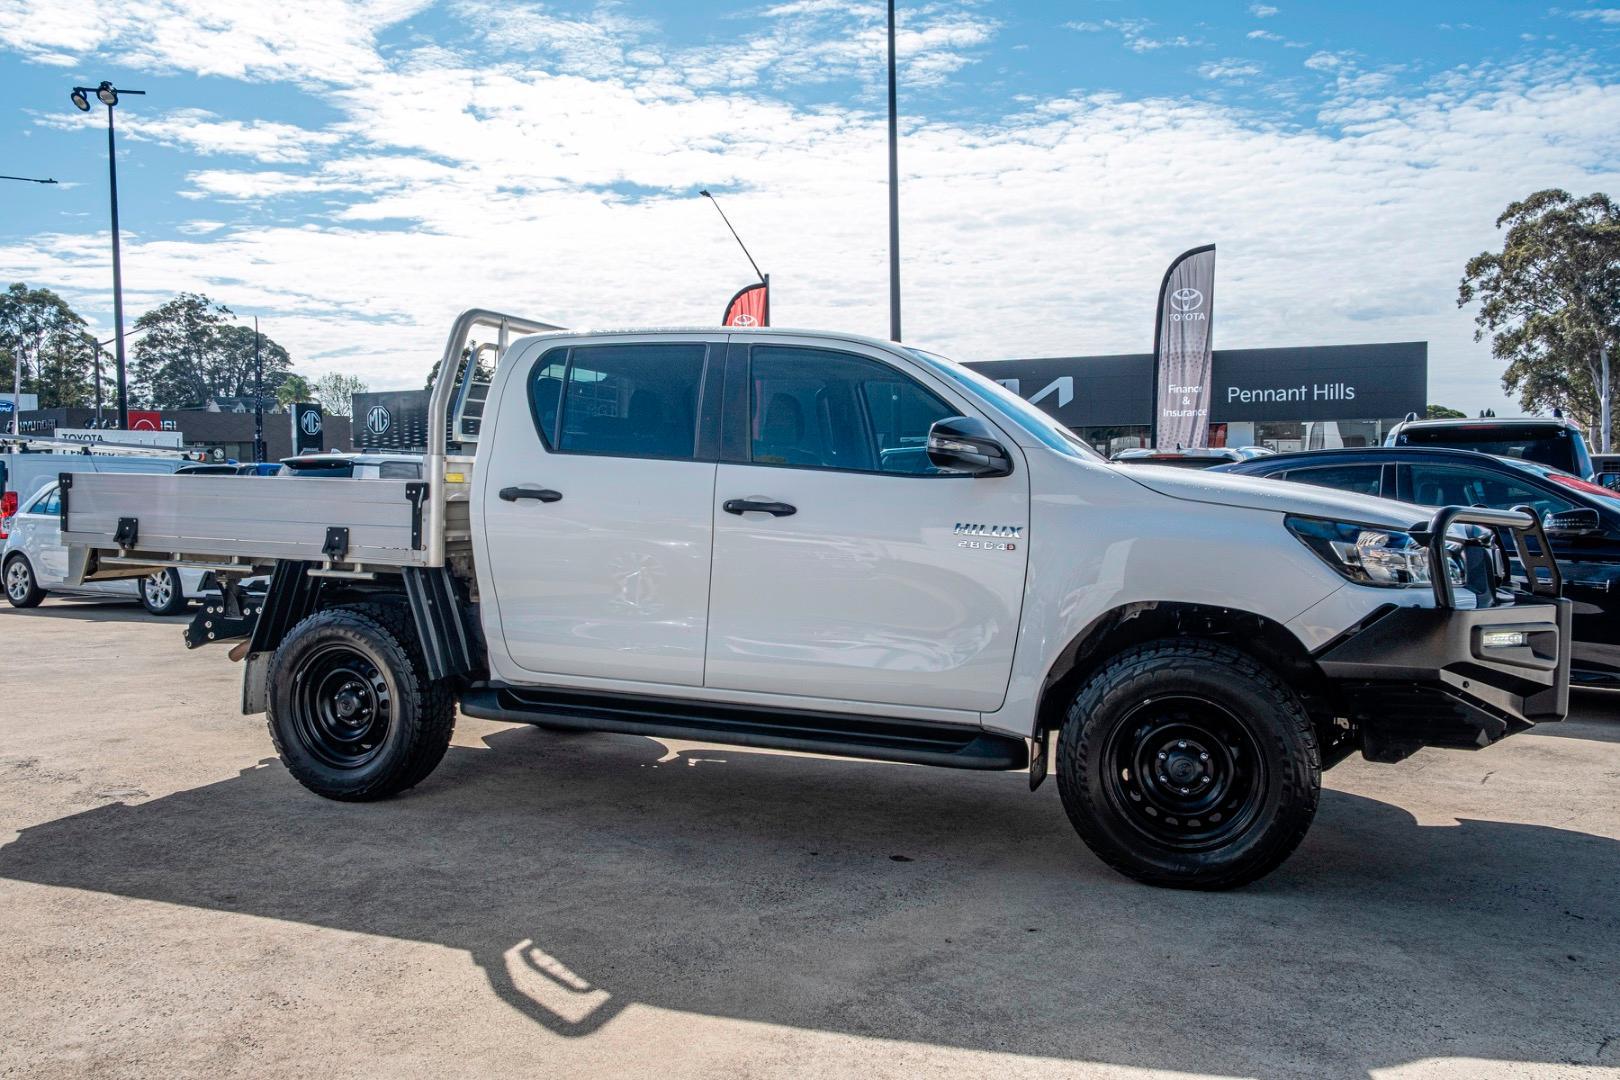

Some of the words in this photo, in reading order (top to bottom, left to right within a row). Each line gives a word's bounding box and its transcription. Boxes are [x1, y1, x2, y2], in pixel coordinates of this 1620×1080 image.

[1169, 312, 1206, 321] TOYOTA
[1168, 384, 1203, 394] Finance
[1228, 386, 1308, 403] Pennant
[1314, 383, 1355, 400] Hills
[1182, 396, 1191, 405] &
[1163, 408, 1208, 417] Insurance
[19, 419, 56, 431] HYUNDAI
[302, 411, 321, 433] MG
[369, 407, 388, 432] MG
[62, 433, 104, 441] TOYOTA
[953, 523, 1023, 538] HILUX
